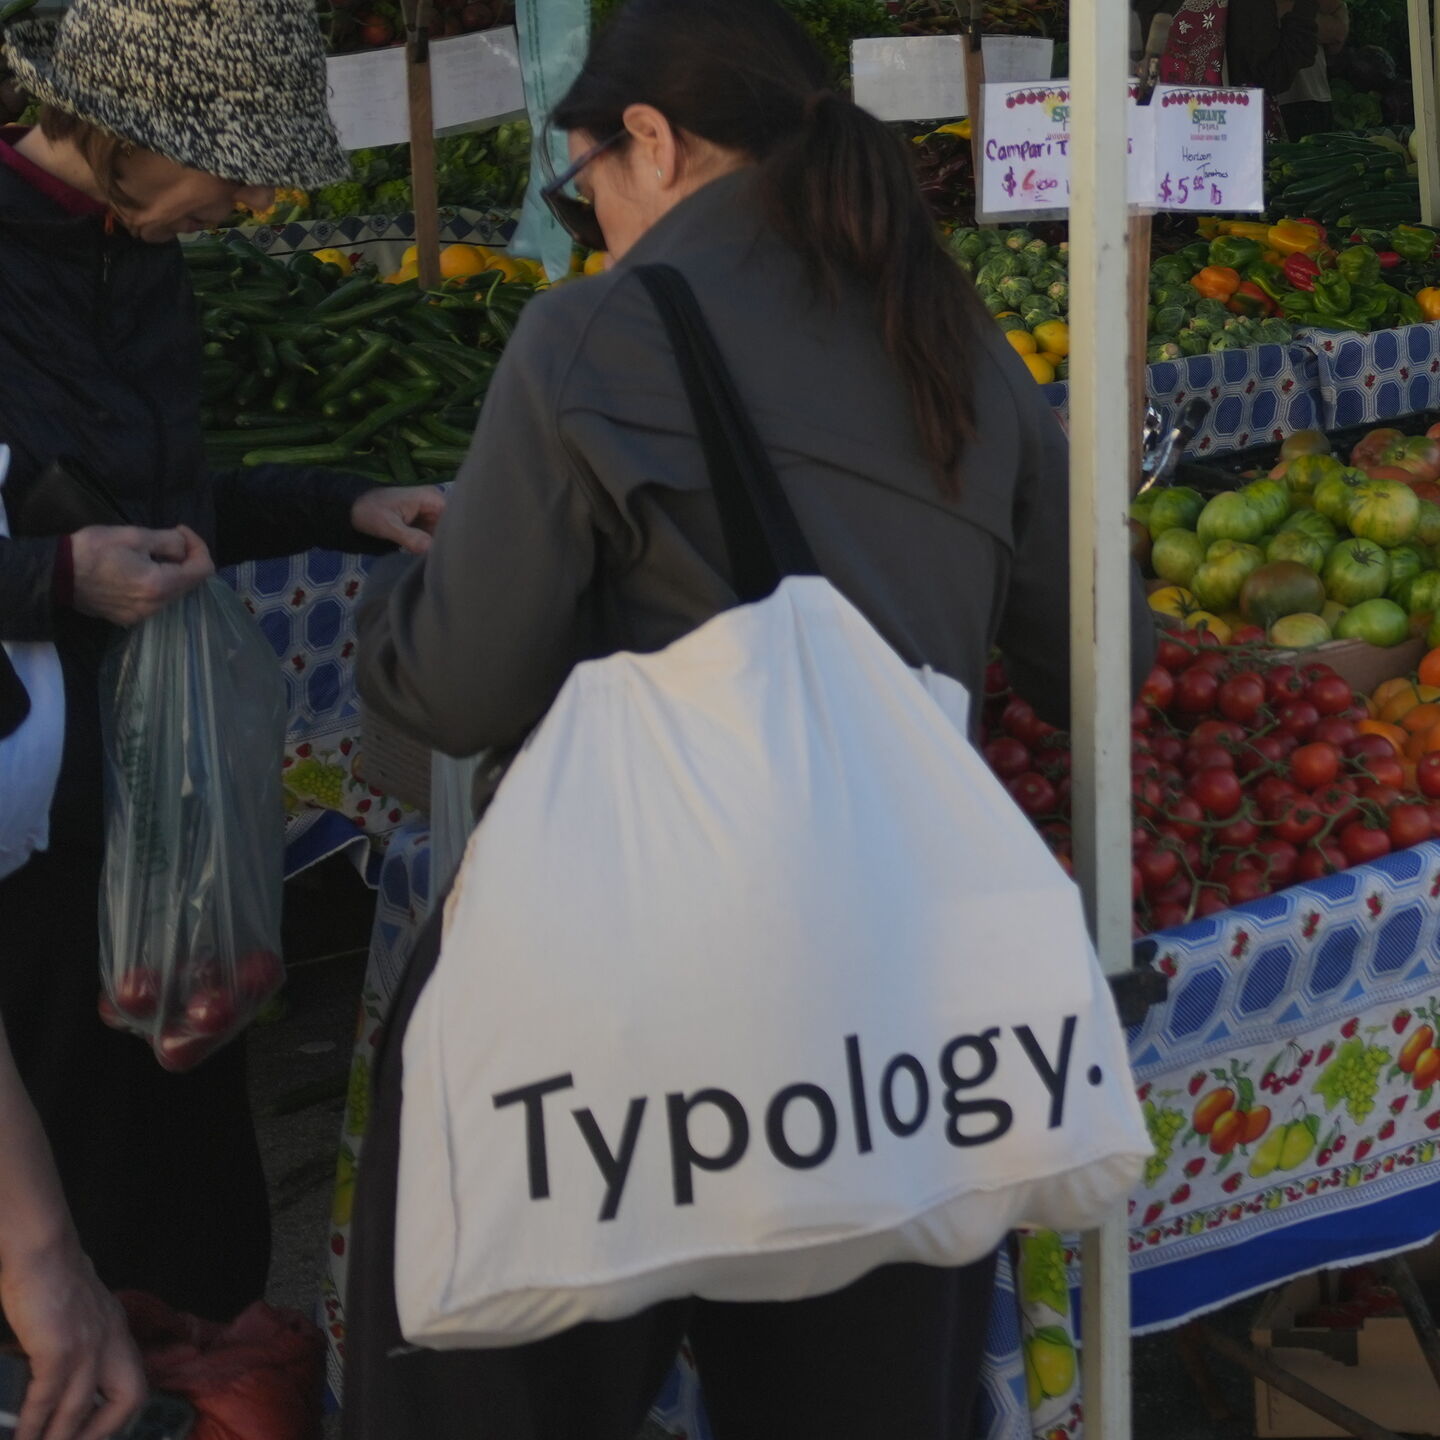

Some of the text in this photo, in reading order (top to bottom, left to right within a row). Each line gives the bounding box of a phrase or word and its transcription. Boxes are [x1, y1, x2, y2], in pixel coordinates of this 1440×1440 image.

[1192, 109, 1227, 125] SWANK
[985, 136, 1052, 162] Campari
[492, 1014, 1103, 1224] Typology.
